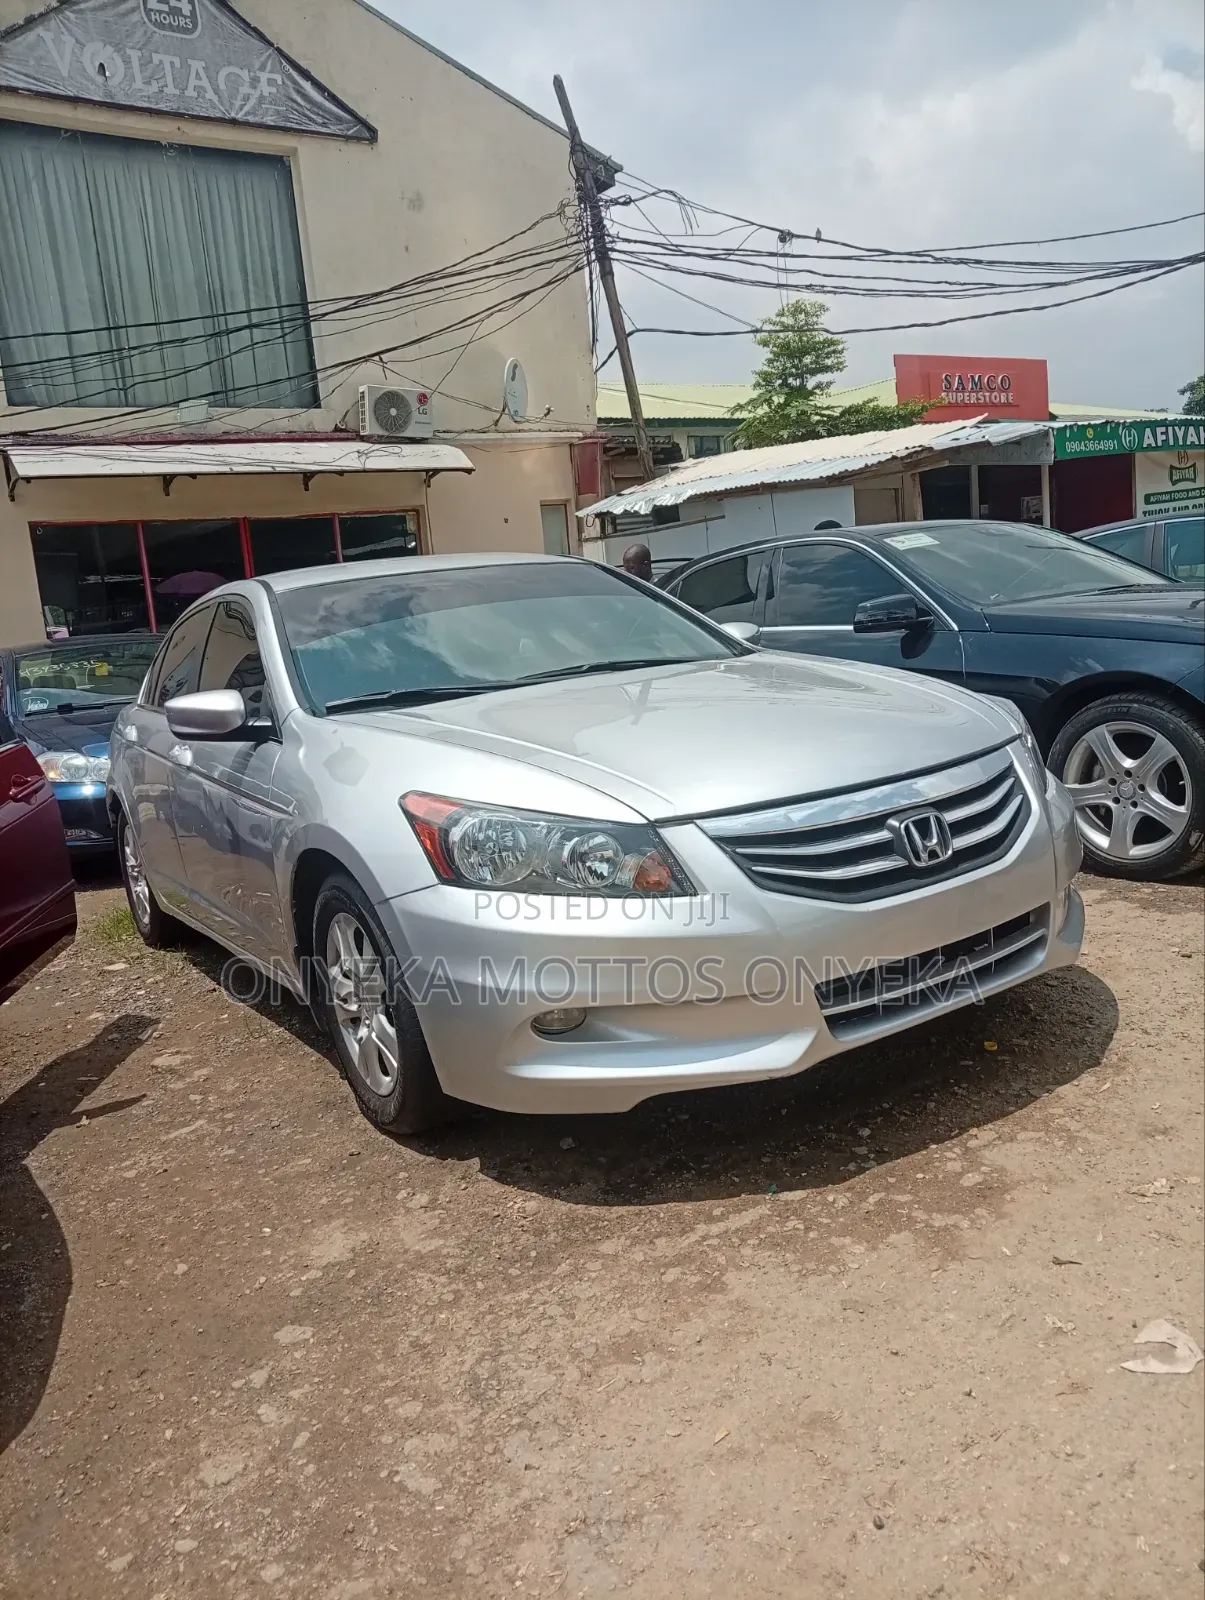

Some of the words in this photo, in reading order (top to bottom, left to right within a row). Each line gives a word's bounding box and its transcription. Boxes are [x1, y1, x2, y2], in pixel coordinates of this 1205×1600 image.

[151, 11, 193, 29] HOURS
[942, 373, 1011, 391] SAMCO
[941, 391, 1014, 405] SUPERSTORE
[417, 406, 428, 416] LG
[1065, 439, 1118, 453] 09043664991
[1172, 466, 1195, 482] AFIYAH
[1150, 493, 1171, 502] AFIYAH
[1171, 491, 1188, 500] FOOD
[1188, 489, 1201, 498] AND
